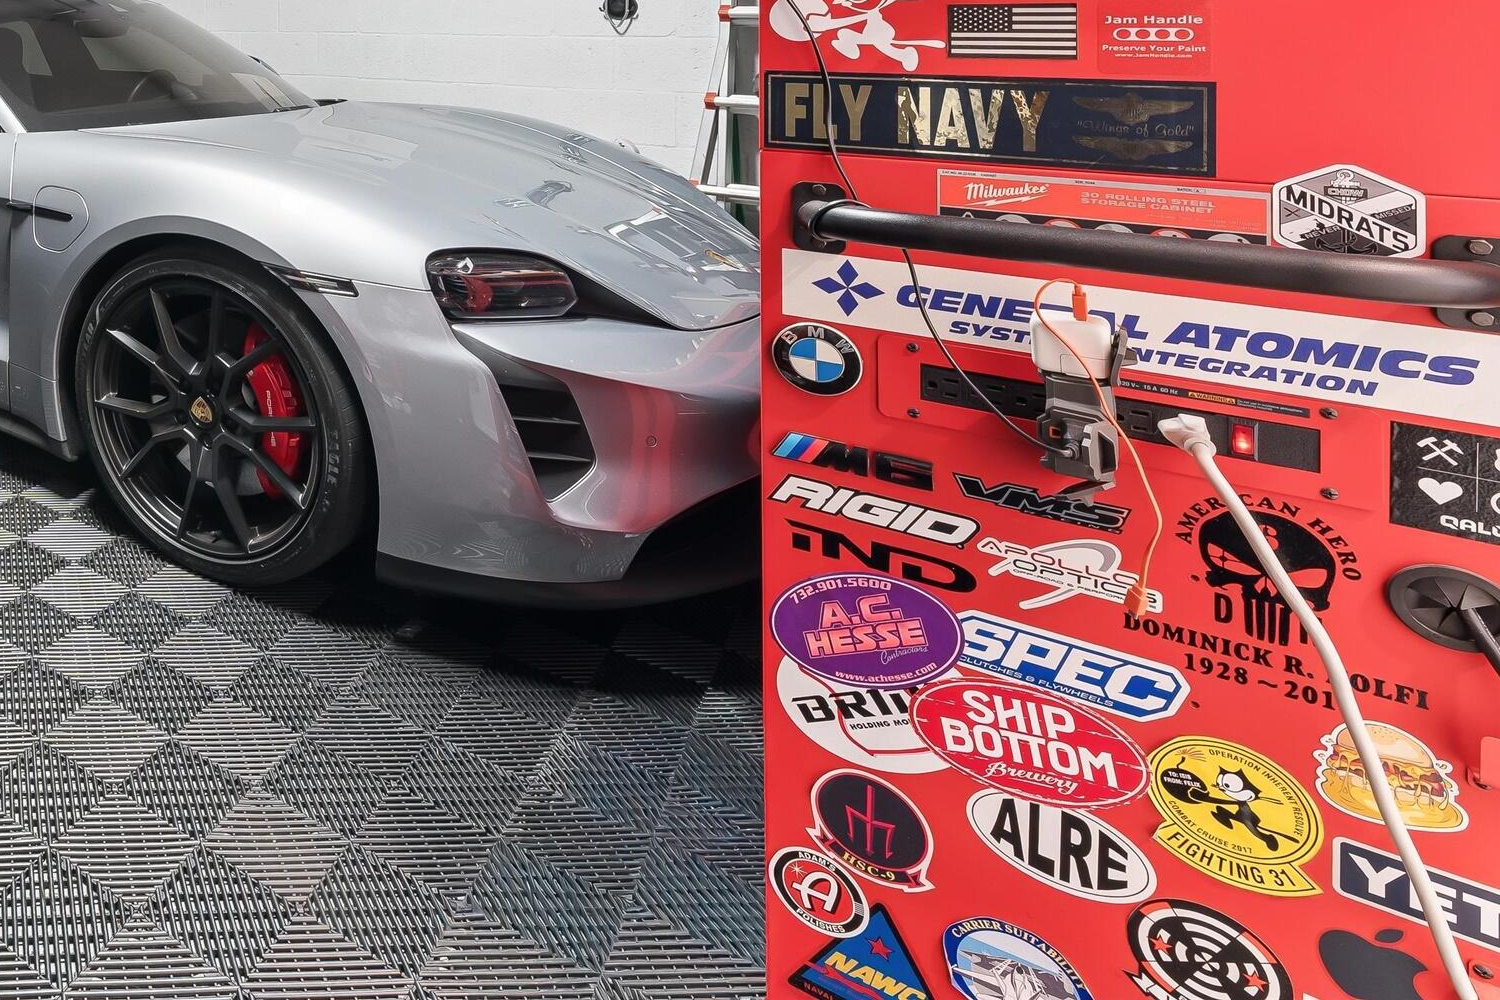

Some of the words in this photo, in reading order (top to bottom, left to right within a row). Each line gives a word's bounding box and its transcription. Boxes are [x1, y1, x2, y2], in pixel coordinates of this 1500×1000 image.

[1105, 15, 1137, 25] Jam
[1143, 14, 1203, 25] Handle
[1102, 44, 1146, 53] Preserve
[1150, 44, 1173, 53] Your
[1178, 44, 1206, 53] Paint
[785, 82, 873, 141] FLY
[897, 86, 1051, 152] NAVY
[964, 182, 1050, 201] Milwaukee
[1080, 191, 1100, 200] 30
[1105, 193, 1169, 204] ROLLING
[1171, 198, 1216, 209] STEEL
[1081, 198, 1146, 210] STORAGE
[1150, 203, 1214, 215] CABINET
[1327, 187, 1364, 199] CHOW
[1375, 204, 1412, 220] MISSED
[1286, 185, 1410, 252] MIDRATS
[1305, 225, 1341, 240] NEVER
[781, 325, 855, 356] BMW
[949, 320, 1032, 346] SYST
[1132, 346, 1379, 397] NTEGRATION
[1163, 321, 1481, 387] ATOMICS
[770, 474, 979, 547] RIGID
[953, 473, 1131, 529] VMS
[1175, 494, 1301, 545] AMERCAN
[1307, 517, 1362, 581] HERO
[981, 540, 1139, 586] APOLLO
[790, 578, 892, 605] 732.901.5600
[820, 593, 903, 629] A.C.
[803, 617, 928, 659] HESSE
[881, 646, 928, 665] Contractors
[835, 662, 937, 682] www.achesse.com
[960, 655, 1023, 680] CLUTCHES
[1039, 679, 1115, 708] FLYWHEELS
[961, 620, 1182, 712] SPEC
[1124, 612, 1273, 668] DOMINICK
[1285, 655, 1314, 679] R.
[1338, 671, 1429, 711] OLFI
[1184, 653, 1249, 685] 1928
[1284, 680, 1336, 711] 201
[850, 720, 890, 731] HOLDING
[962, 690, 1076, 740] SHIP
[940, 717, 1119, 790] BOTTOM
[985, 761, 1078, 796] Brewery
[1183, 779, 1201, 788] FELIX
[1209, 748, 1261, 772] OPERATION
[1262, 770, 1297, 807] INHERENT
[990, 798, 1128, 890] ALRE
[1168, 800, 1197, 829] COMBAT
[1196, 827, 1230, 849] CRUISE
[798, 851, 836, 872] ADAM'S
[843, 852, 896, 882] HSC-9
[1166, 831, 1265, 886] FIGHTING
[1268, 868, 1296, 888] 31
[796, 908, 846, 934] POLISHES
[952, 920, 1001, 938] CARRIER
[1005, 924, 1086, 989] SUITABILITY
